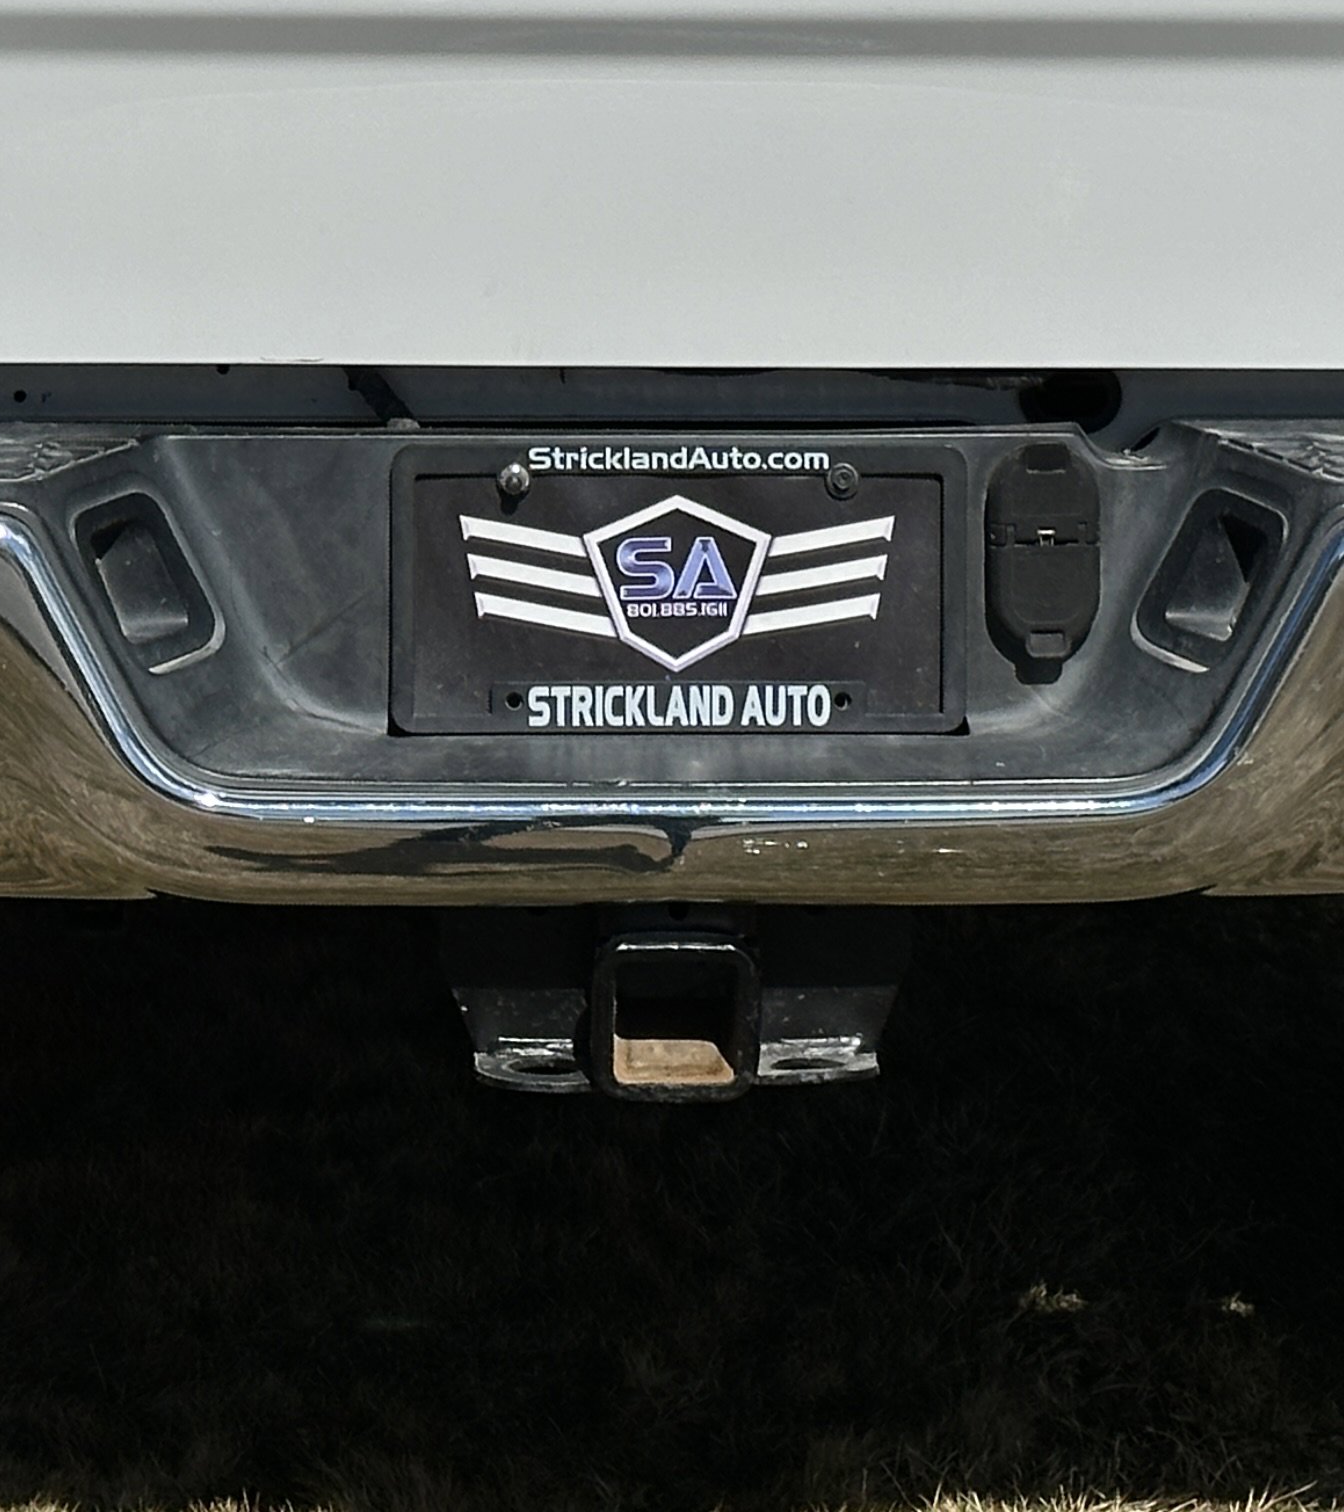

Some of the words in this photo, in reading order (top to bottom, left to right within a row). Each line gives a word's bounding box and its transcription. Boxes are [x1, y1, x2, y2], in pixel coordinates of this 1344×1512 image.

[528, 446, 830, 471] StricklandAuto.com
[616, 536, 737, 600] SA
[528, 686, 734, 726] STRICKLAND
[741, 685, 831, 726] AUTO
